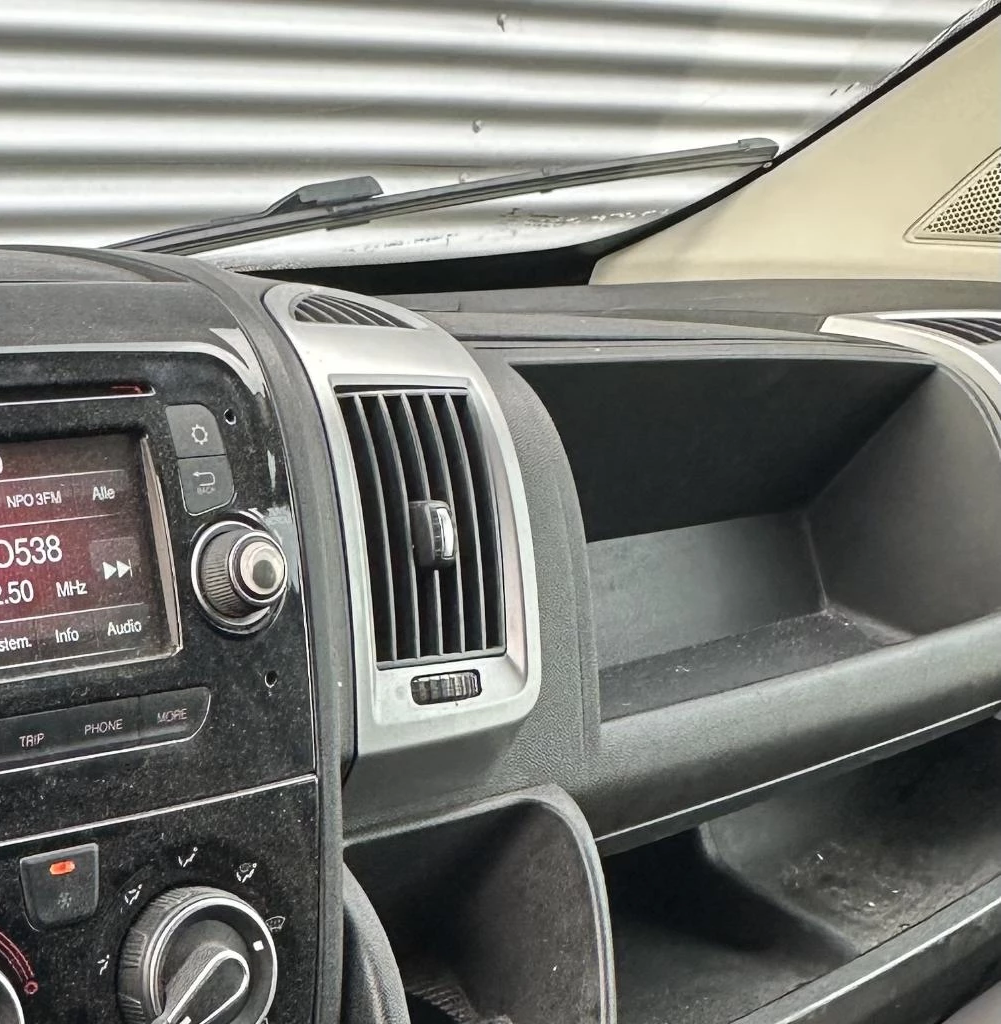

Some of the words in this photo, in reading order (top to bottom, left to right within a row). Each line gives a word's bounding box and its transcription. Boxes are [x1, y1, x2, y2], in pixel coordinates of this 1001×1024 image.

[6, 494, 34, 508] NPO
[35, 490, 63, 506] 3FM
[92, 486, 116, 501] Alle
[55, 580, 88, 598] MHz
[55, 627, 80, 644] Info
[107, 619, 142, 637] Audio
[157, 708, 188, 724] MORE
[84, 719, 123, 735] PHONE
[19, 732, 45, 748] TRIP
